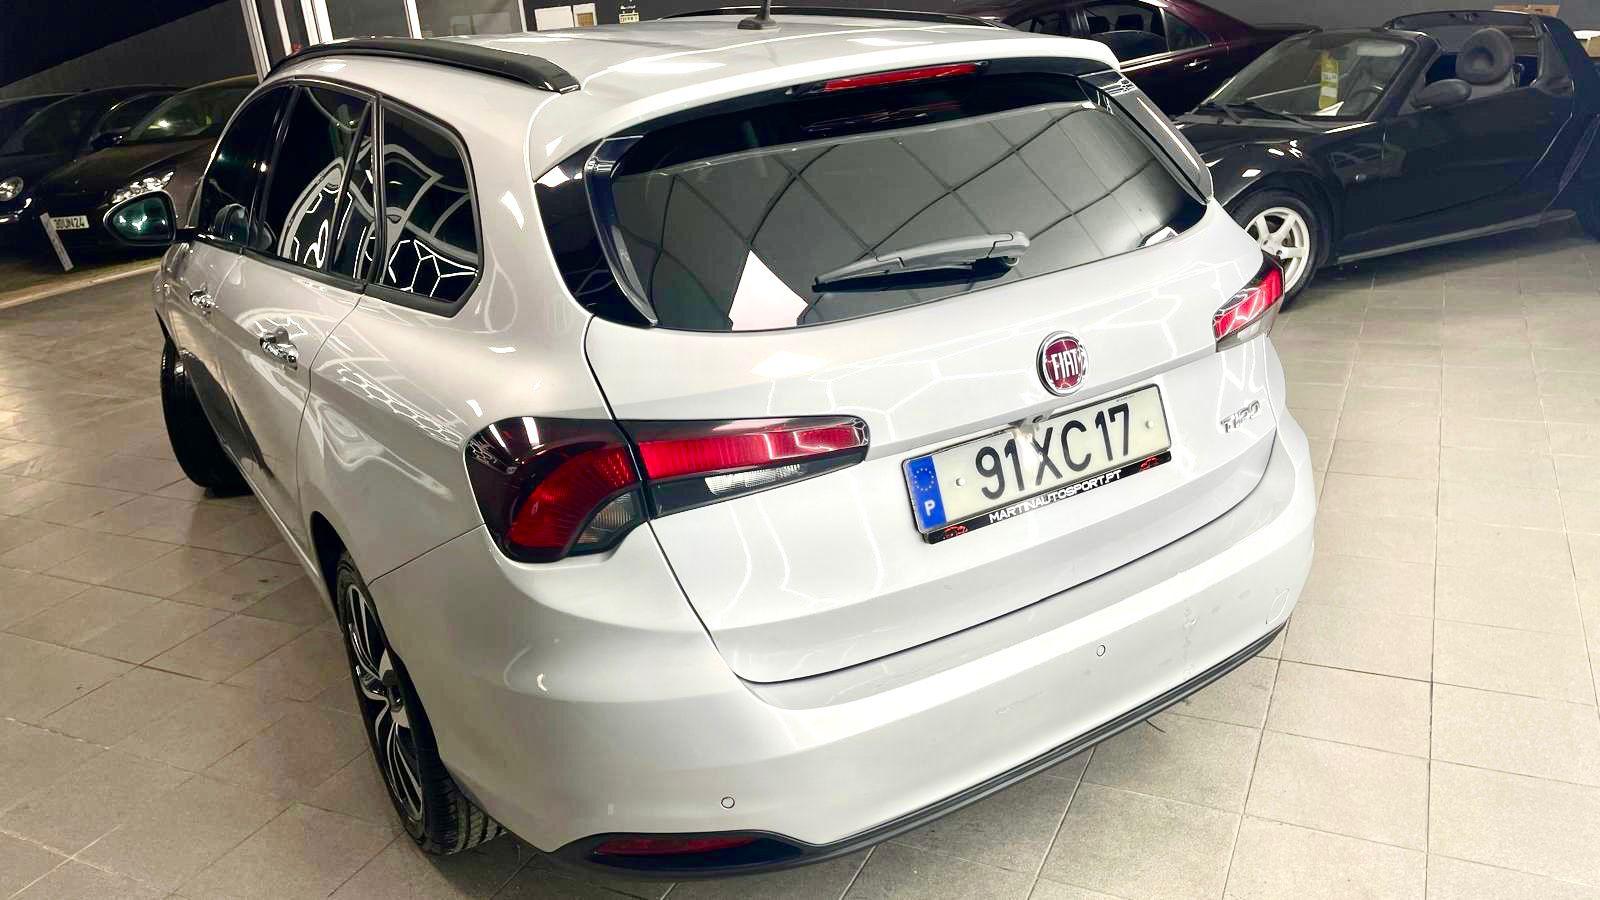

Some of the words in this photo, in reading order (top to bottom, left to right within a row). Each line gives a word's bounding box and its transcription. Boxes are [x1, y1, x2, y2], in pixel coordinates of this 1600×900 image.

[1050, 348, 1080, 381] FIAT
[1220, 399, 1261, 433] TIPO
[924, 499, 936, 517] P
[988, 469, 1122, 524] MARTINAUTOSPORT.PT
